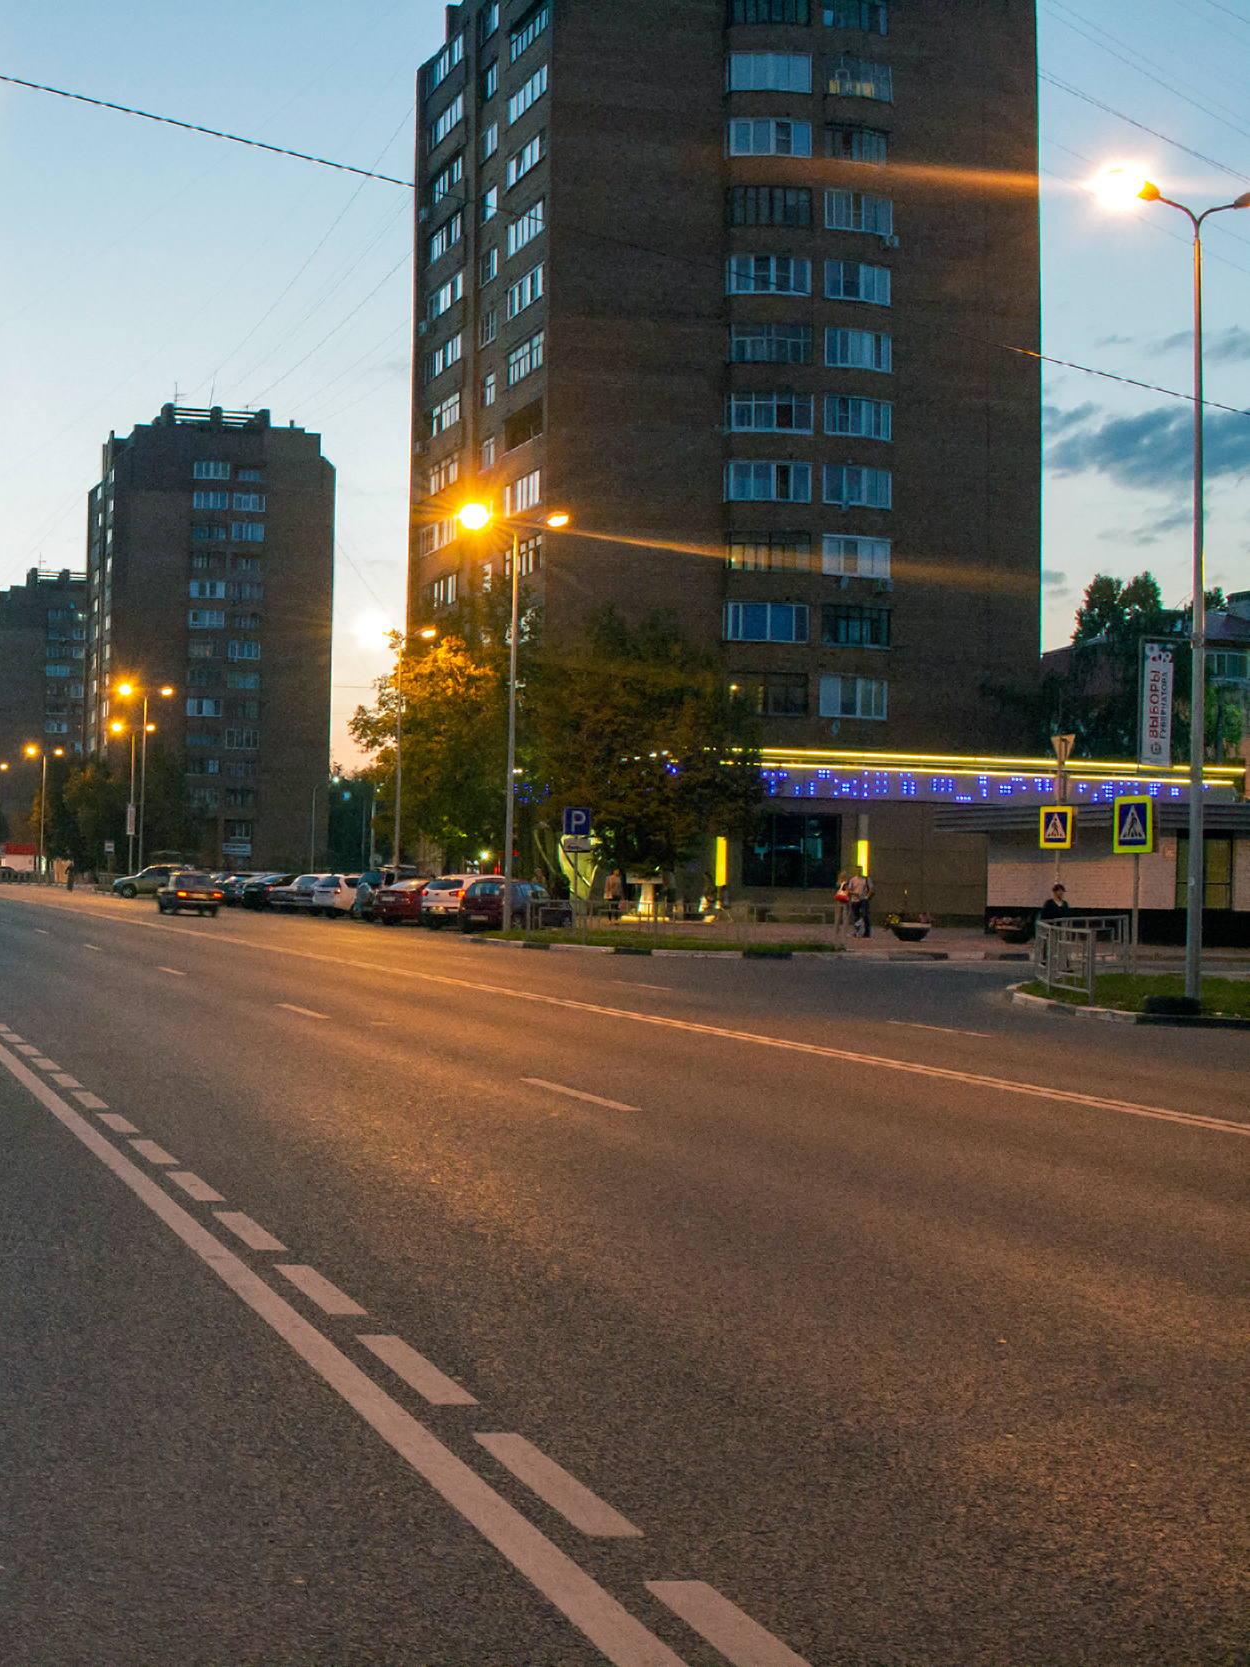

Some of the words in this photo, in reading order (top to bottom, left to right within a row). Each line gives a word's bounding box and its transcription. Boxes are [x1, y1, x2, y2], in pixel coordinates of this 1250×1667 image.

[1148, 670, 1160, 739] ВЫБОРЫ
[1160, 671, 1168, 740] ГУБЕРНАТОРА
[571, 810, 586, 832] P
